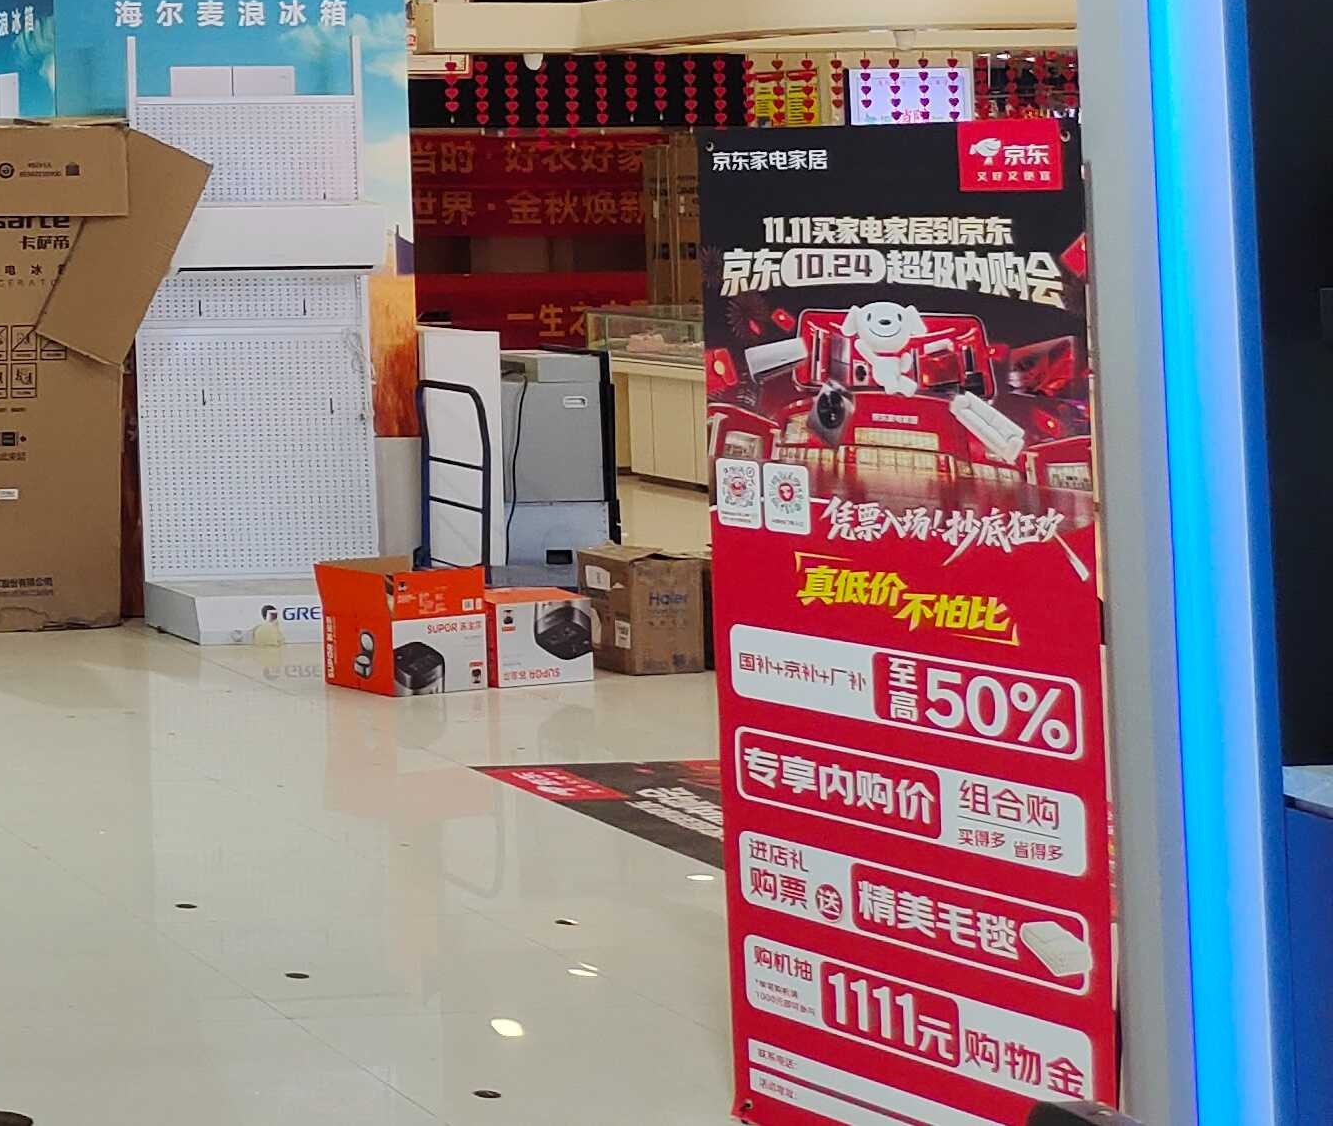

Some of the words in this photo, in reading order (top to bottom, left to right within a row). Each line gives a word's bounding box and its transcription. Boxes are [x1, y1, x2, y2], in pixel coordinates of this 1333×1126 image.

[712, 148, 829, 172] 京东家电家居
[1003, 144, 1050, 166] 京东
[977, 170, 1052, 183] 又好又便宜
[20, 235, 71, 251] 卡萨帝
[762, 216, 1014, 247] 11.11买家电家居到京东
[282, 605, 320, 622] GRE
[648, 590, 688, 606] Haier
[796, 564, 1012, 633] 真低价不怕比
[427, 622, 458, 634] SUPOR
[739, 650, 868, 693] 国补+京补+厂补
[887, 656, 919, 723] 至高
[925, 666, 1071, 751] 50%
[743, 745, 936, 826] 专享内购价
[958, 778, 1061, 832] 组合购
[748, 837, 809, 873] 进店礼
[958, 827, 1006, 850] 买得多
[1014, 840, 1064, 862] 省得多
[749, 866, 809, 911] 购票
[815, 884, 844, 920] 送
[856, 879, 1021, 961] 精美毛毯
[753, 945, 814, 984] 购机抽
[828, 970, 956, 1063] 1111元
[965, 1029, 1085, 1099] 购物金
